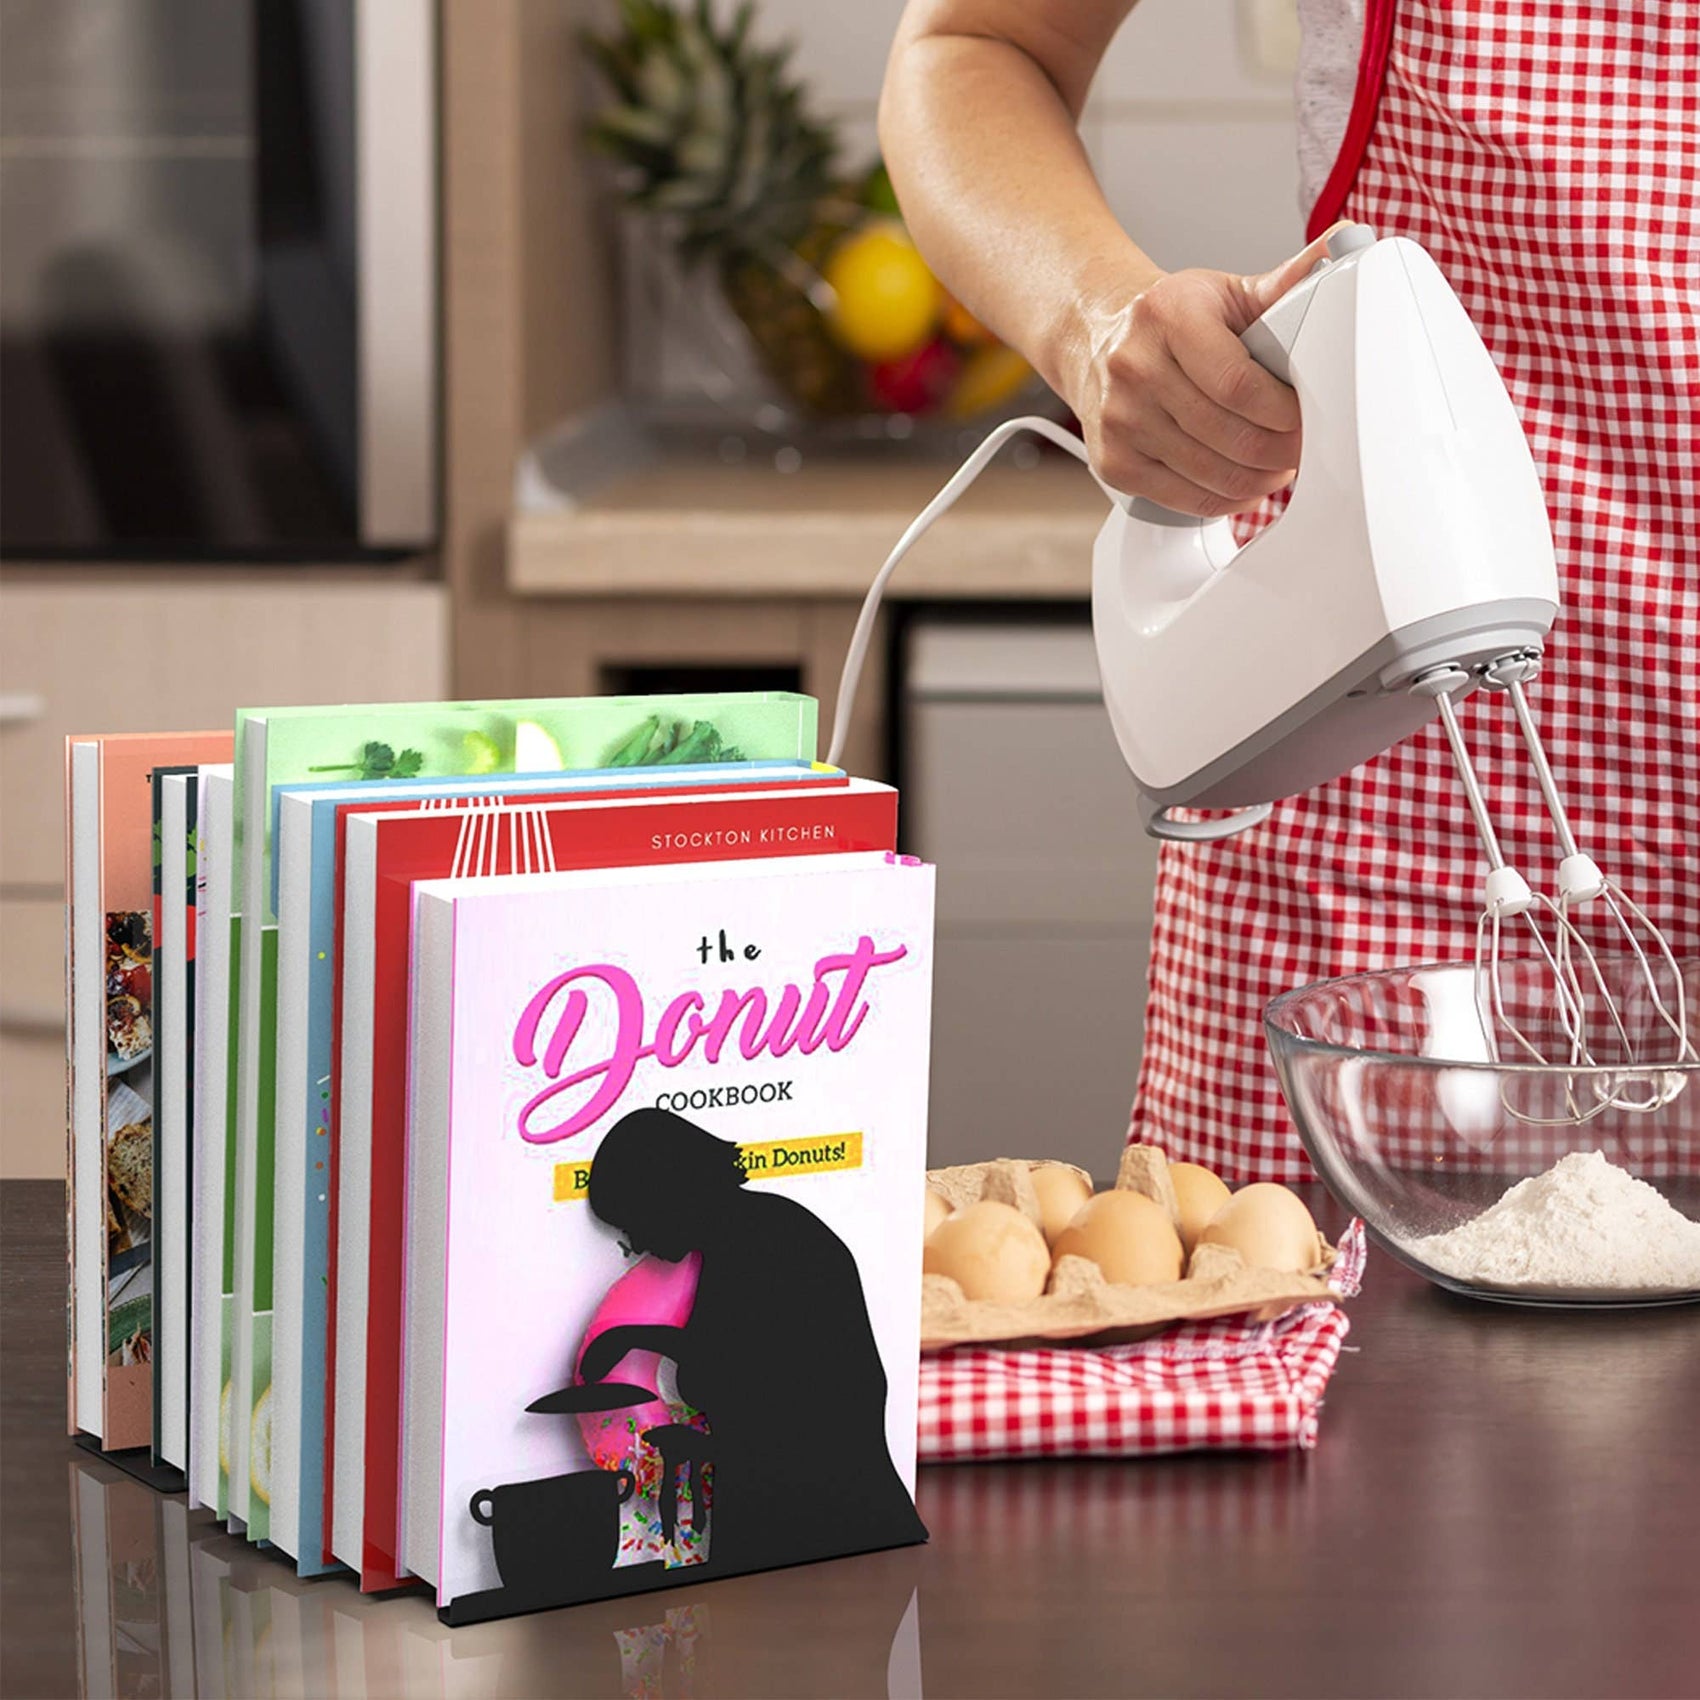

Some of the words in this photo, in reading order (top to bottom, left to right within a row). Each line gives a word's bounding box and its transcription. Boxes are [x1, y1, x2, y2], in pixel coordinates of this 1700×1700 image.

[651, 830, 751, 850] STOCKTON
[759, 825, 835, 843] KITCHEN
[696, 929, 762, 964] the
[512, 935, 908, 1145] Donut
[655, 1080, 793, 1112] COOKBOOK
[772, 1141, 846, 1168] Donuts!
